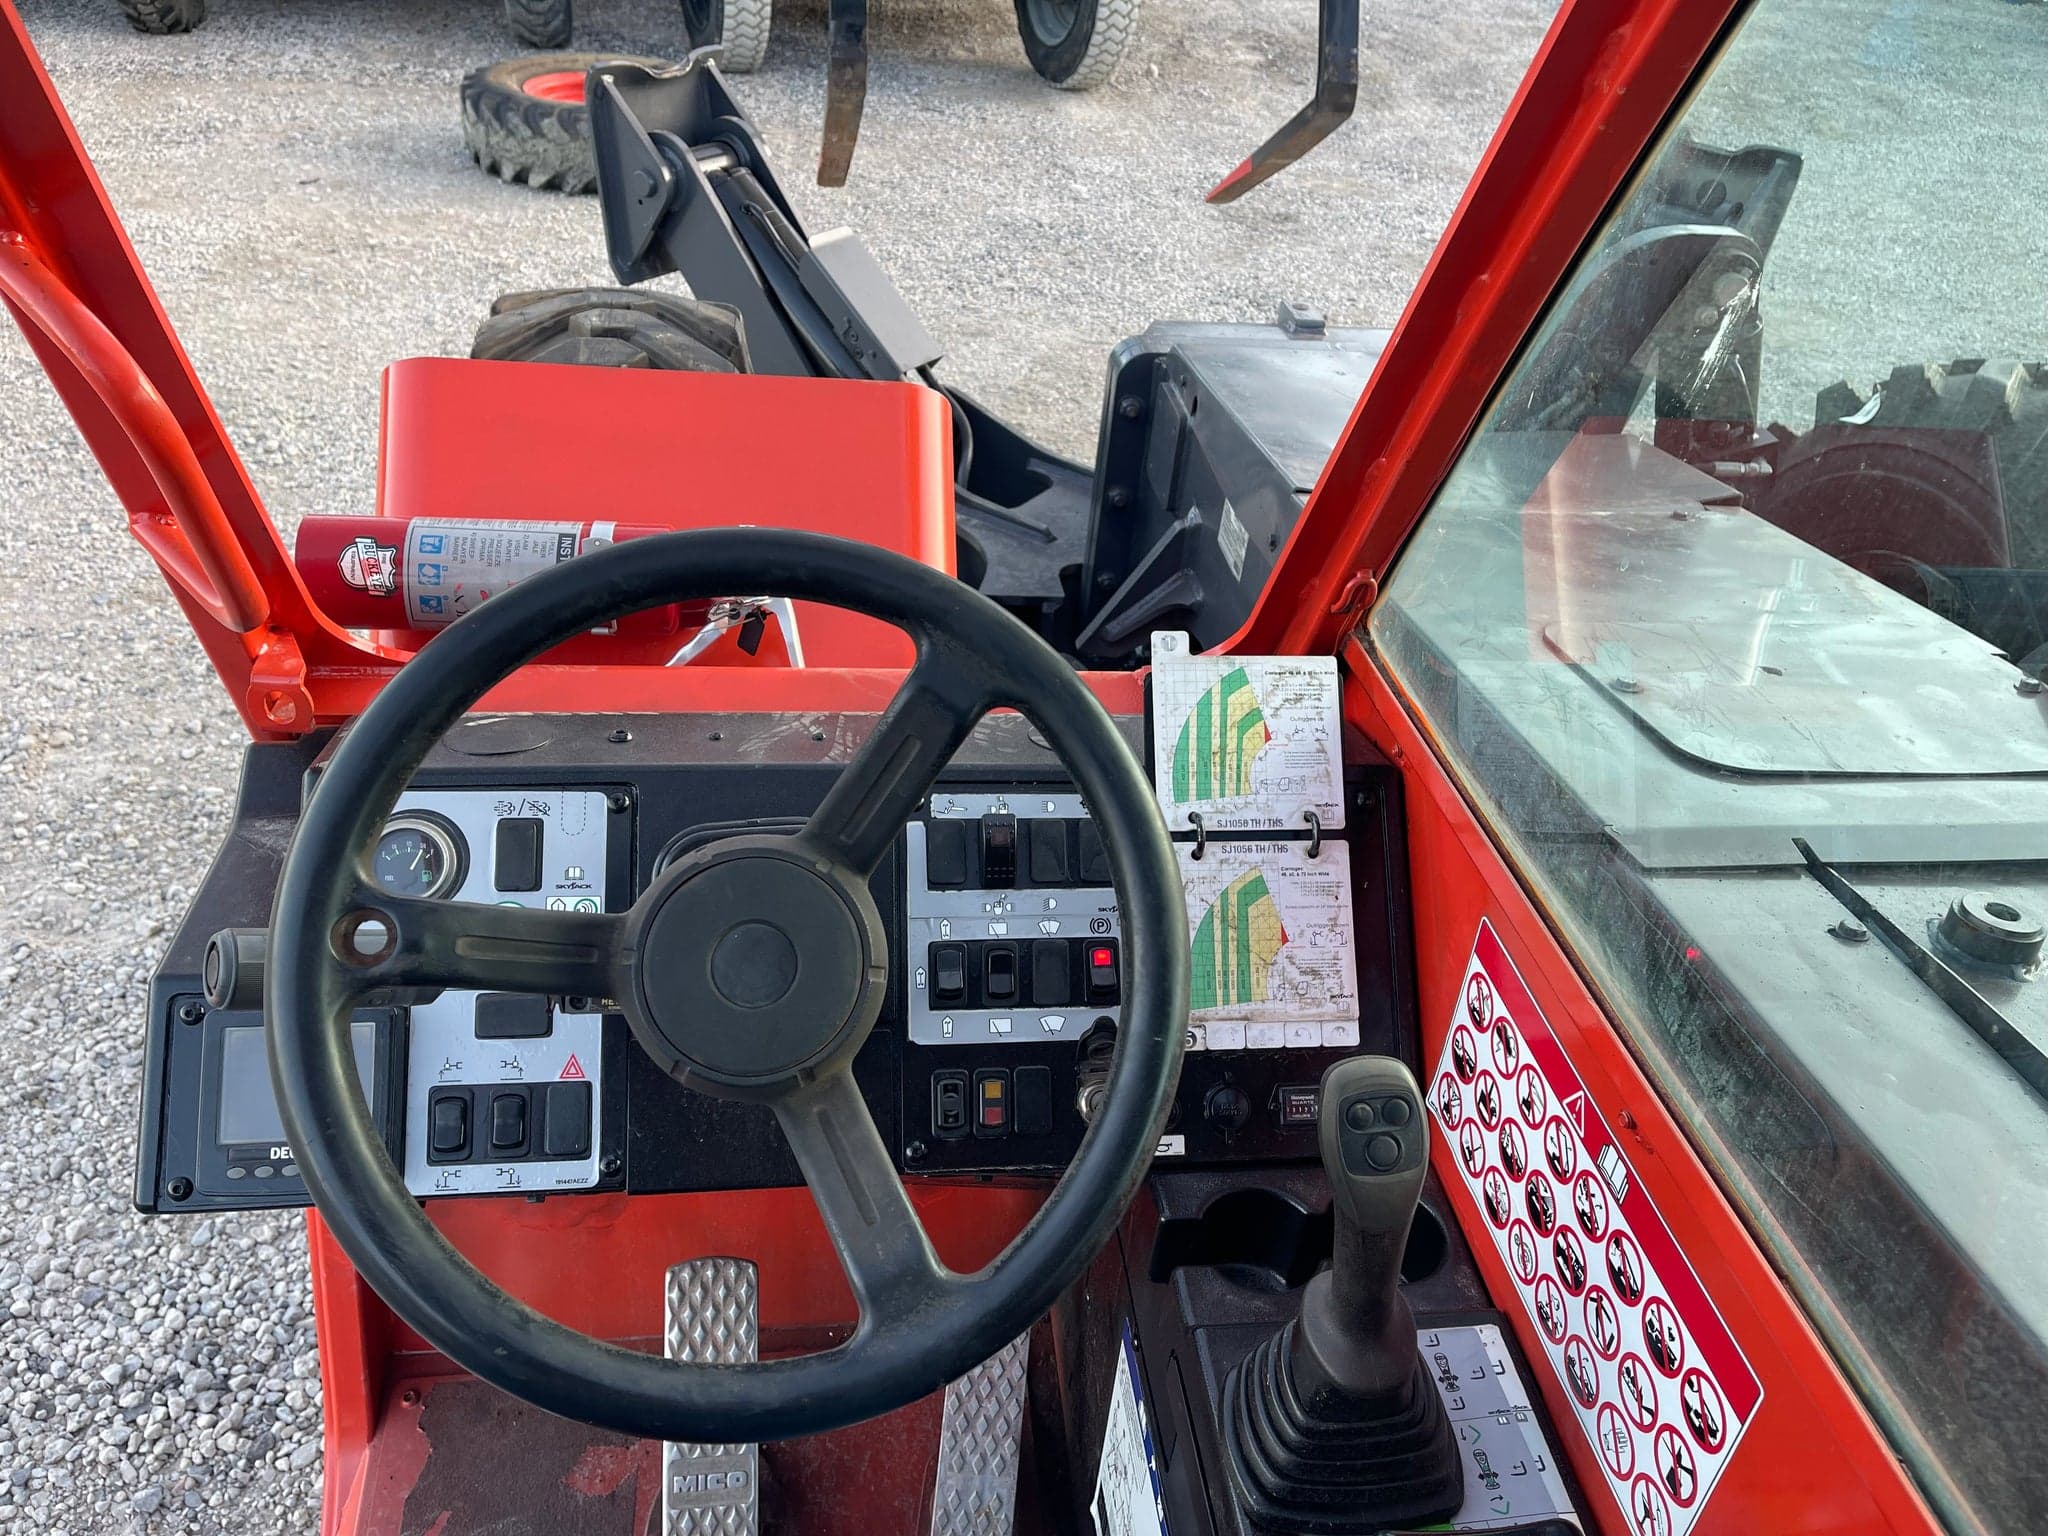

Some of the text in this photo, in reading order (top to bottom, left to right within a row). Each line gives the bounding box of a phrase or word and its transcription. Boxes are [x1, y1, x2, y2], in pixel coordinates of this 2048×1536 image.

[494, 538, 502, 568] SQUEEZE
[560, 537, 573, 562] INST
[363, 544, 385, 589] BUCKEYE
[1221, 844, 1253, 854] SJ1056
[1272, 844, 1289, 853] THS
[555, 882, 593, 890] SKYJACK
[673, 1471, 748, 1494] MICO
